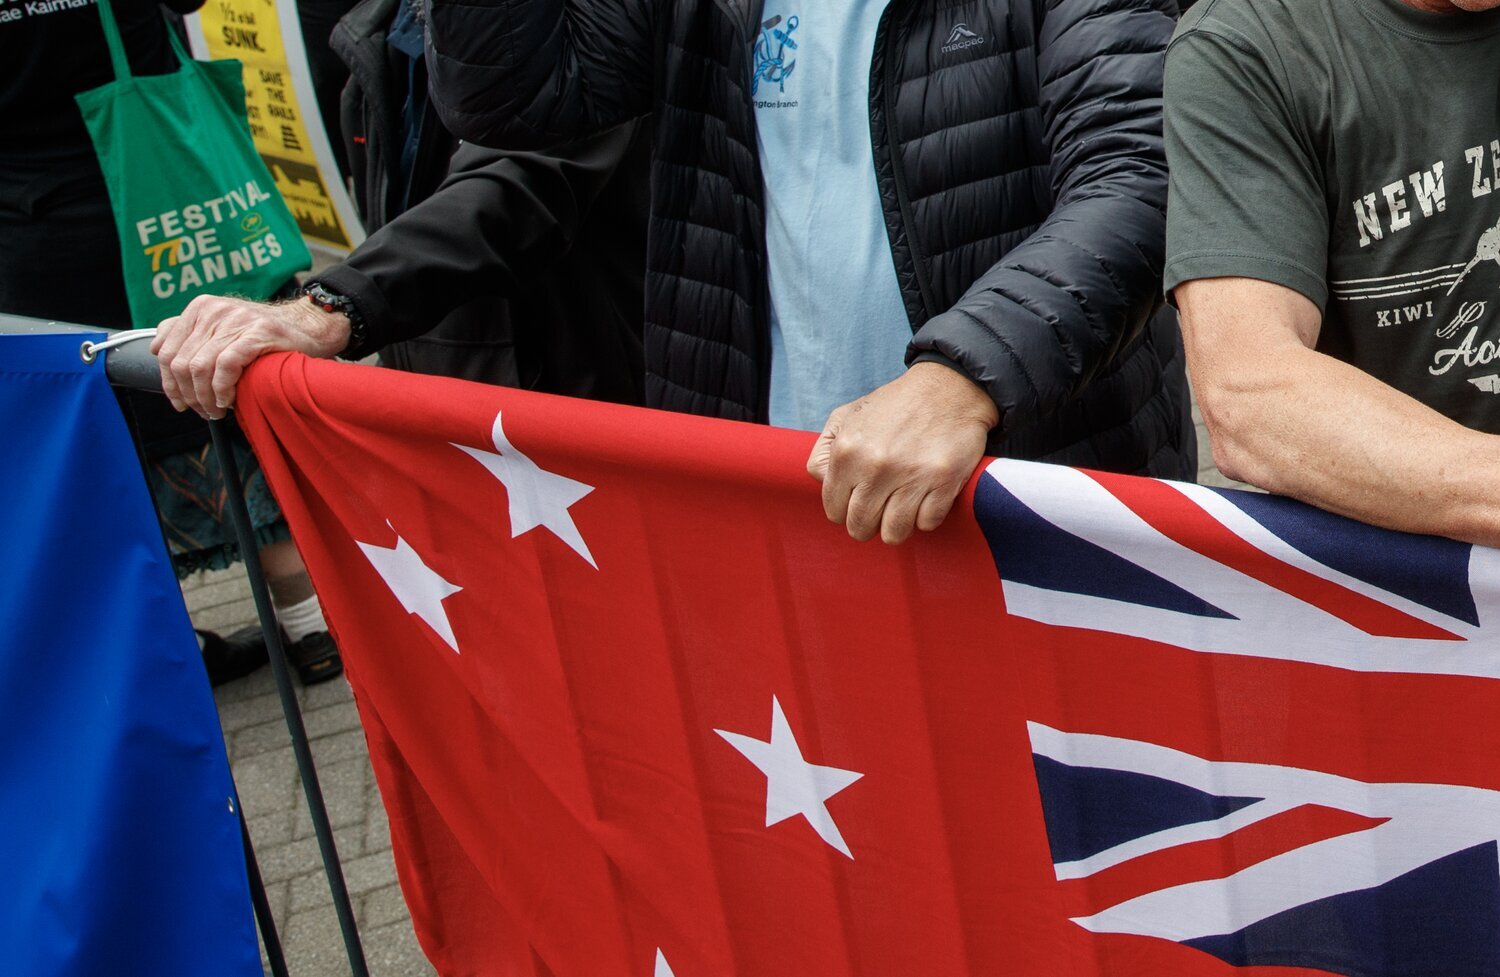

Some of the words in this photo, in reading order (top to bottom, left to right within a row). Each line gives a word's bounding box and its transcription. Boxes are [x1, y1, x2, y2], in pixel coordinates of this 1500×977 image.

[941, 35, 984, 54] macpac
[136, 180, 272, 246] FESTIVAL
[1352, 161, 1447, 248] NEW
[152, 233, 283, 299] CANNES
[178, 227, 222, 264] DE
[1376, 301, 1434, 328] KIWI
